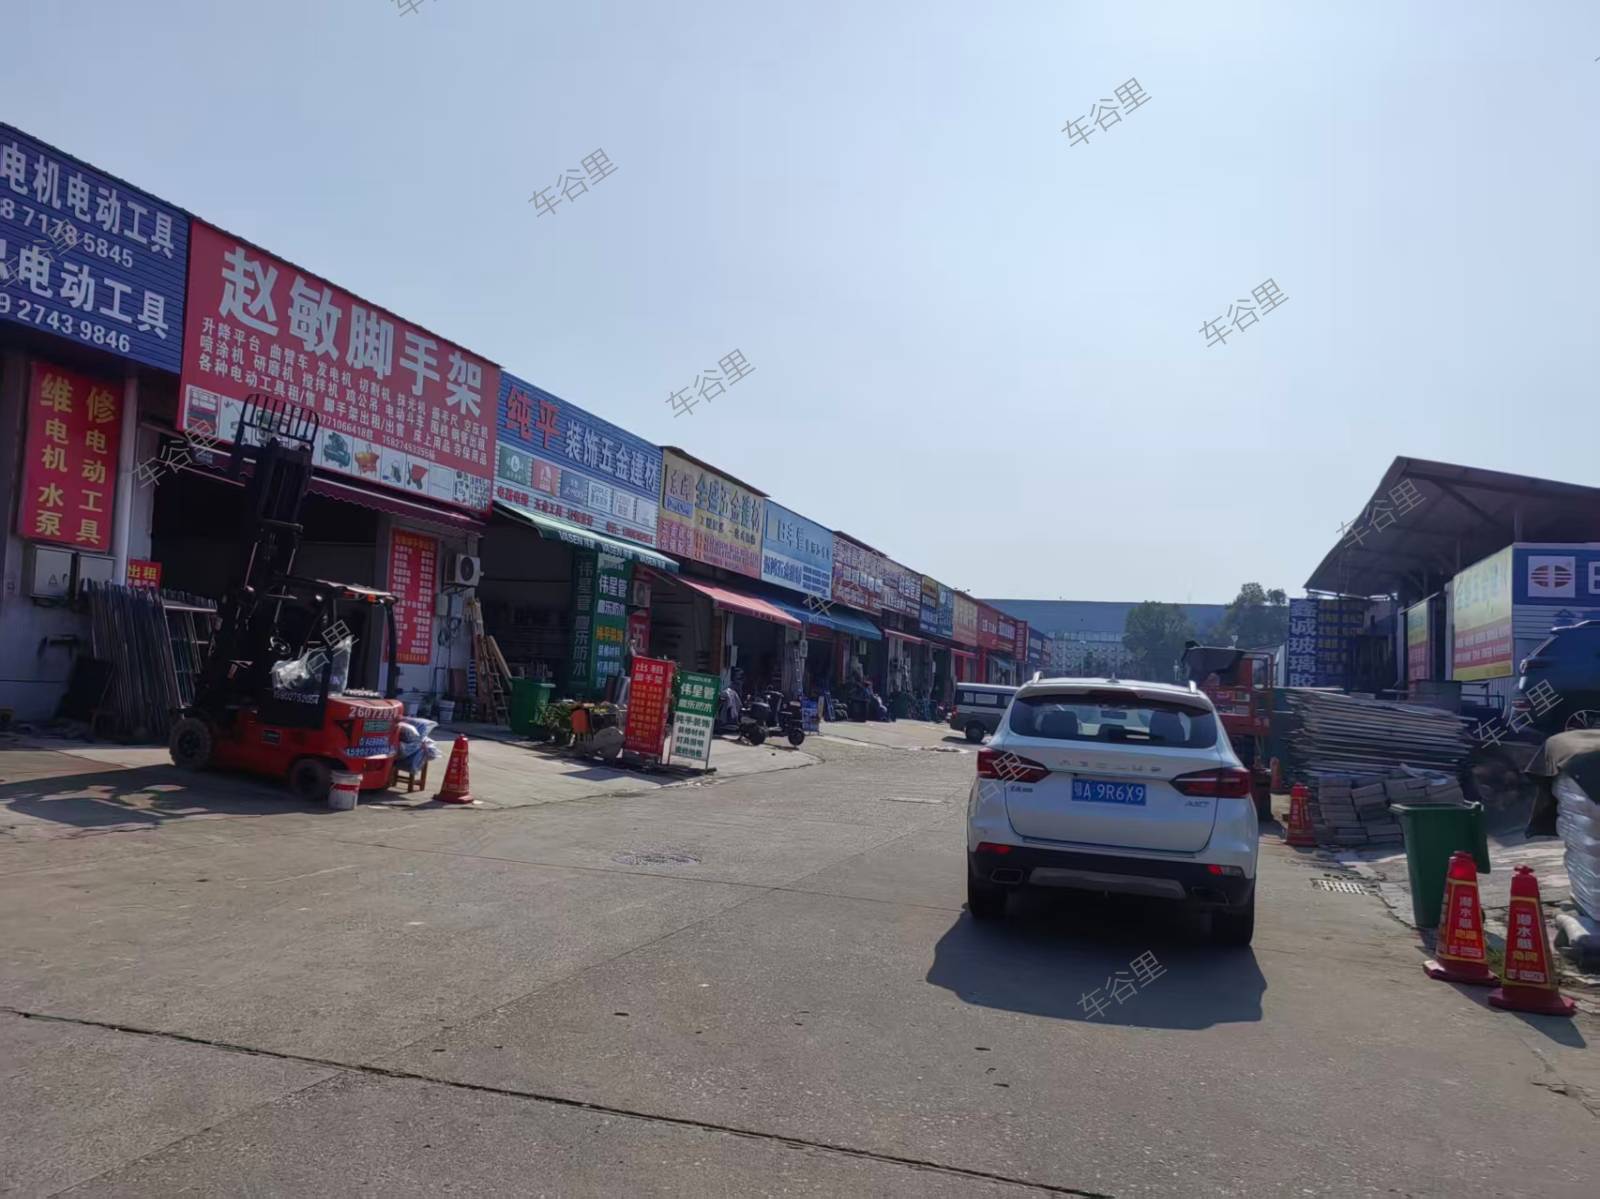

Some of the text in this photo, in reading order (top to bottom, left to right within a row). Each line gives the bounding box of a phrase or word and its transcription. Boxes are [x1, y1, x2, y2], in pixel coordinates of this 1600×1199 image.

[83, 233, 134, 269] 5845
[17, 299, 74, 335] 2743
[80, 320, 131, 353] 9846
[219, 246, 482, 417] 赵敏脚手架
[36, 418, 69, 536] 电机水泵
[75, 429, 109, 544] 电动工具
[565, 421, 658, 492] 装饰五金建材
[636, 663, 664, 675] 出租
[681, 683, 715, 700] 伟星管
